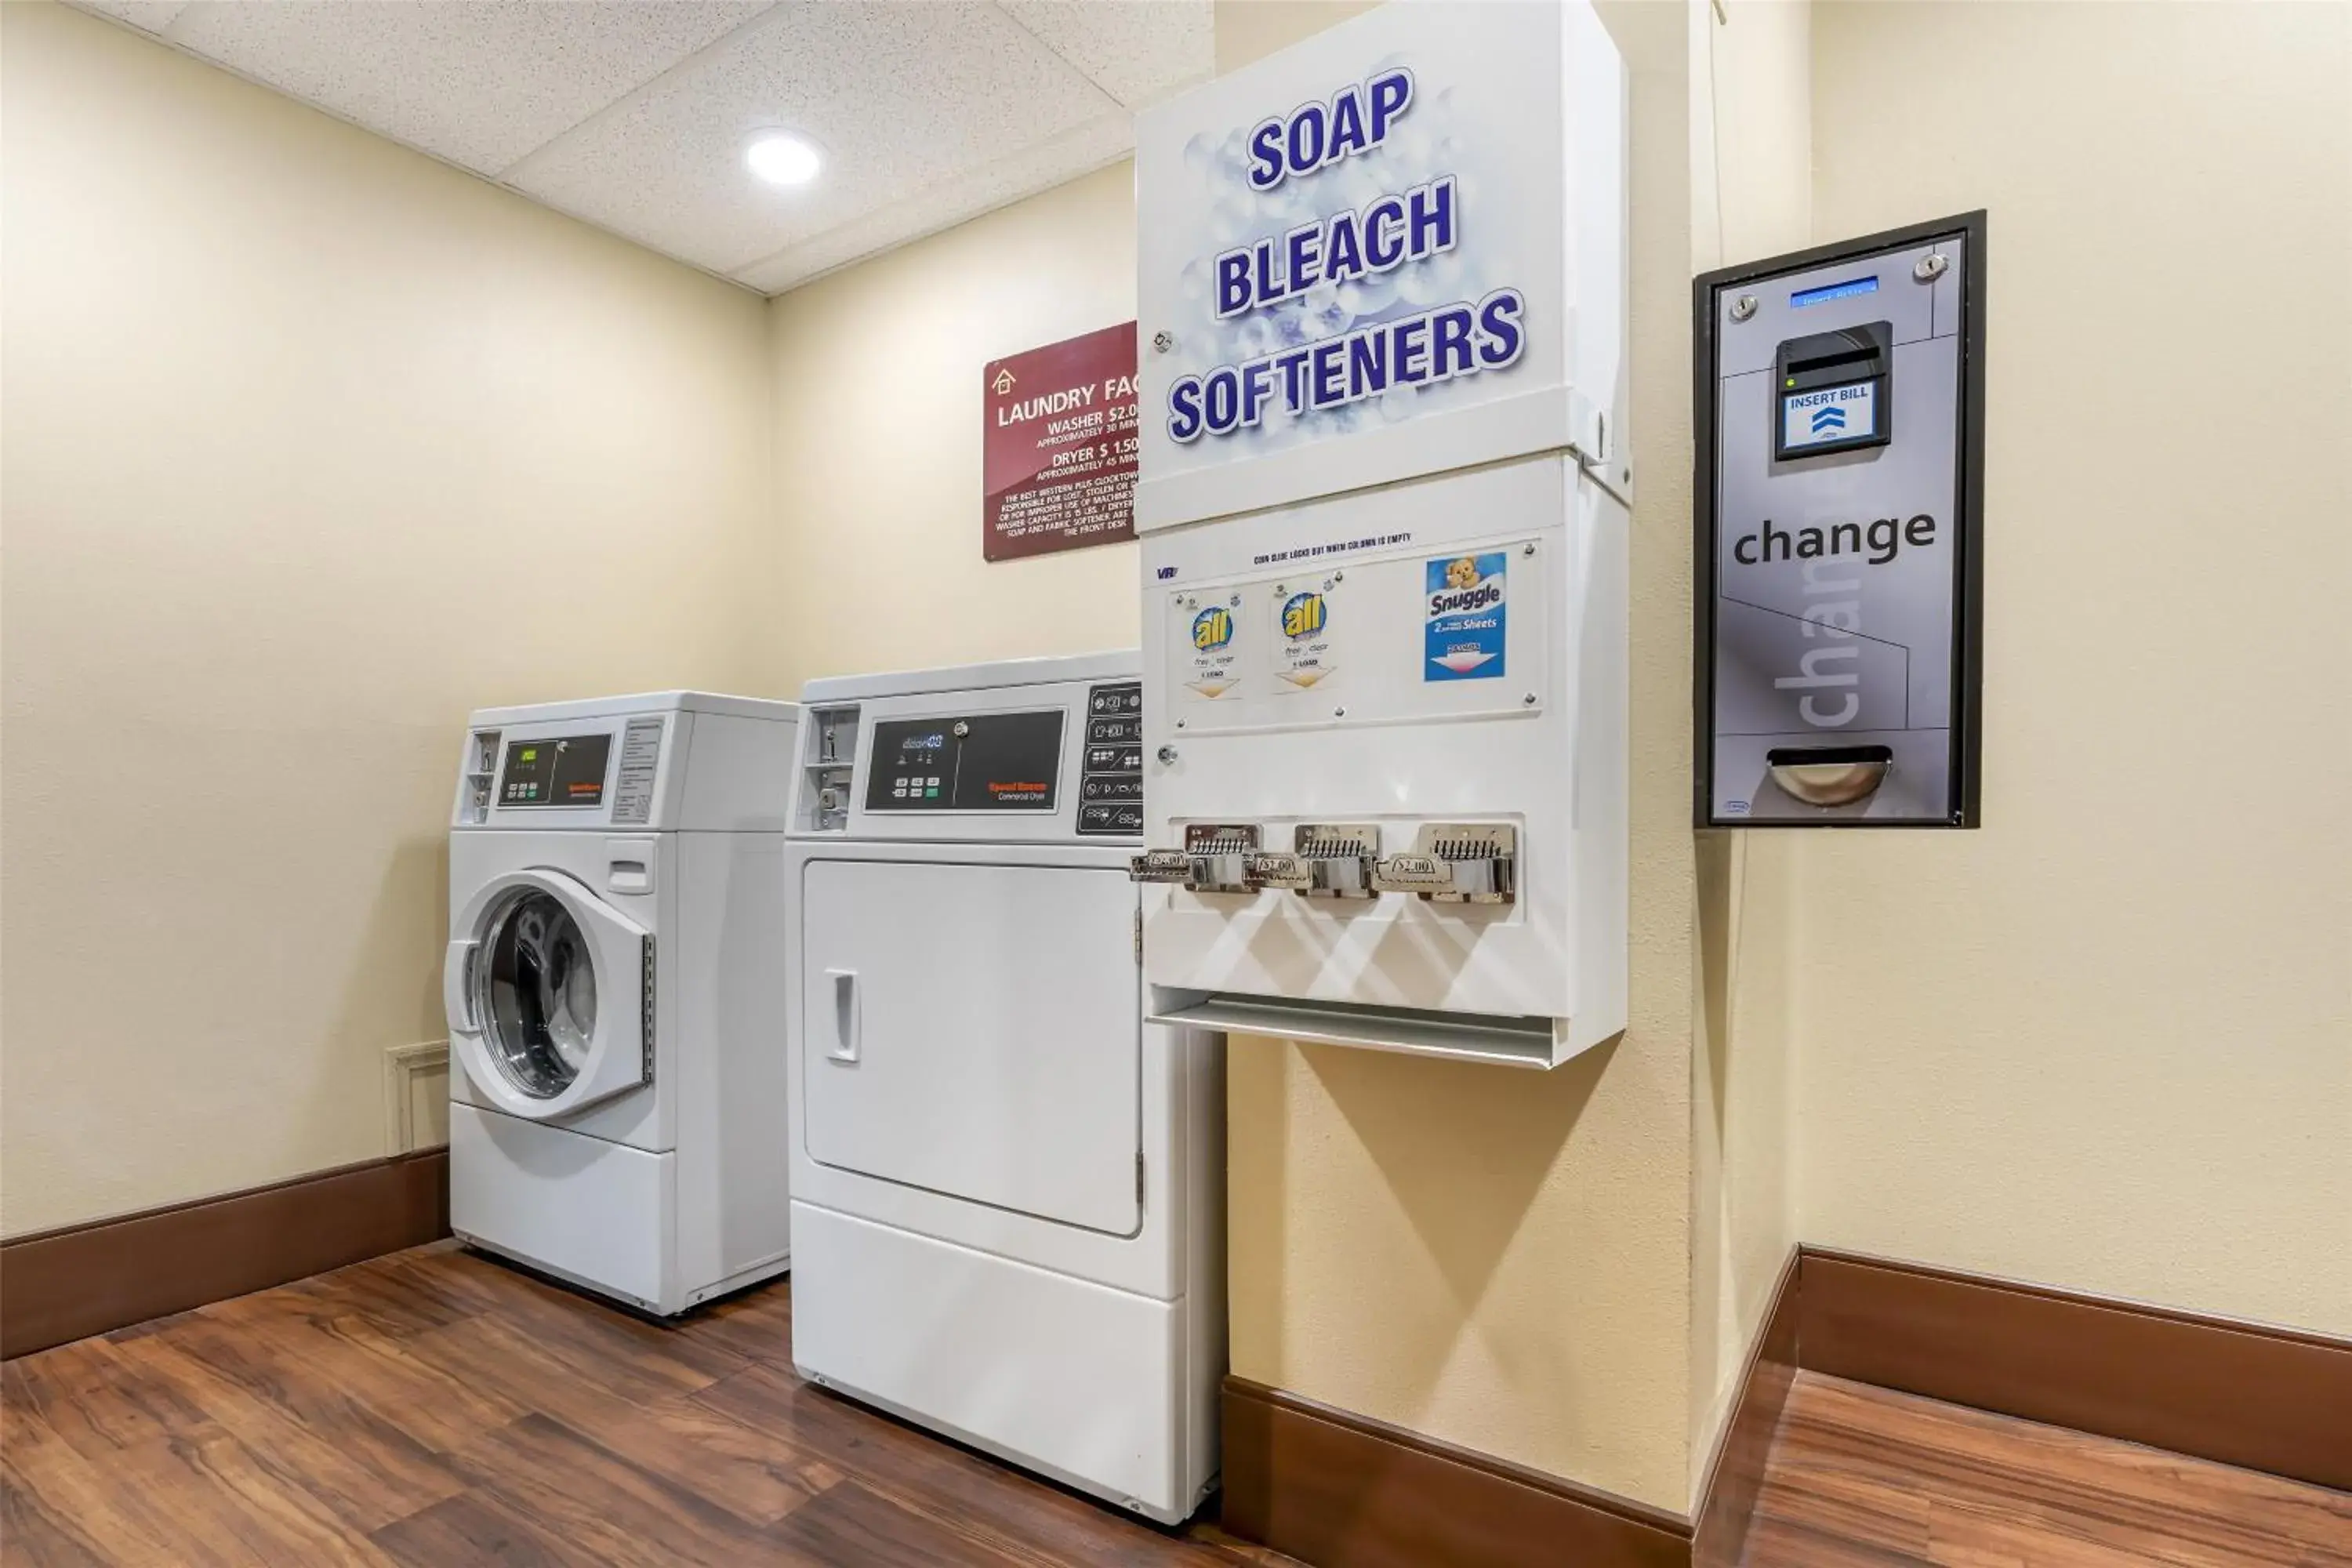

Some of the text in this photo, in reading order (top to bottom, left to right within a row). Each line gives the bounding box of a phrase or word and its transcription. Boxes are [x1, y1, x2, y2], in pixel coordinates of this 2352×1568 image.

[1251, 71, 1410, 188] SOAP
[1217, 180, 1453, 316] BLEACH
[1171, 293, 1520, 440] SOFTENERS
[998, 383, 1097, 427] LAUNDRY
[1791, 387, 1868, 409] INSERT BILL
[1036, 426, 1103, 449] APPROXIMATELY
[1048, 412, 1103, 436] WASHER
[1053, 447, 1094, 467] DRYER
[1100, 443, 1109, 457] $
[1036, 460, 1103, 483] APPROXIMATELY
[1290, 547, 1310, 559] LOCKS
[1387, 532, 1412, 545] EMPTY
[1733, 513, 1936, 566] change
[1286, 593, 1323, 637] all
[1430, 584, 1501, 616] Snuggle
[1194, 608, 1229, 650] all
[1462, 618, 1497, 630] Sheets
